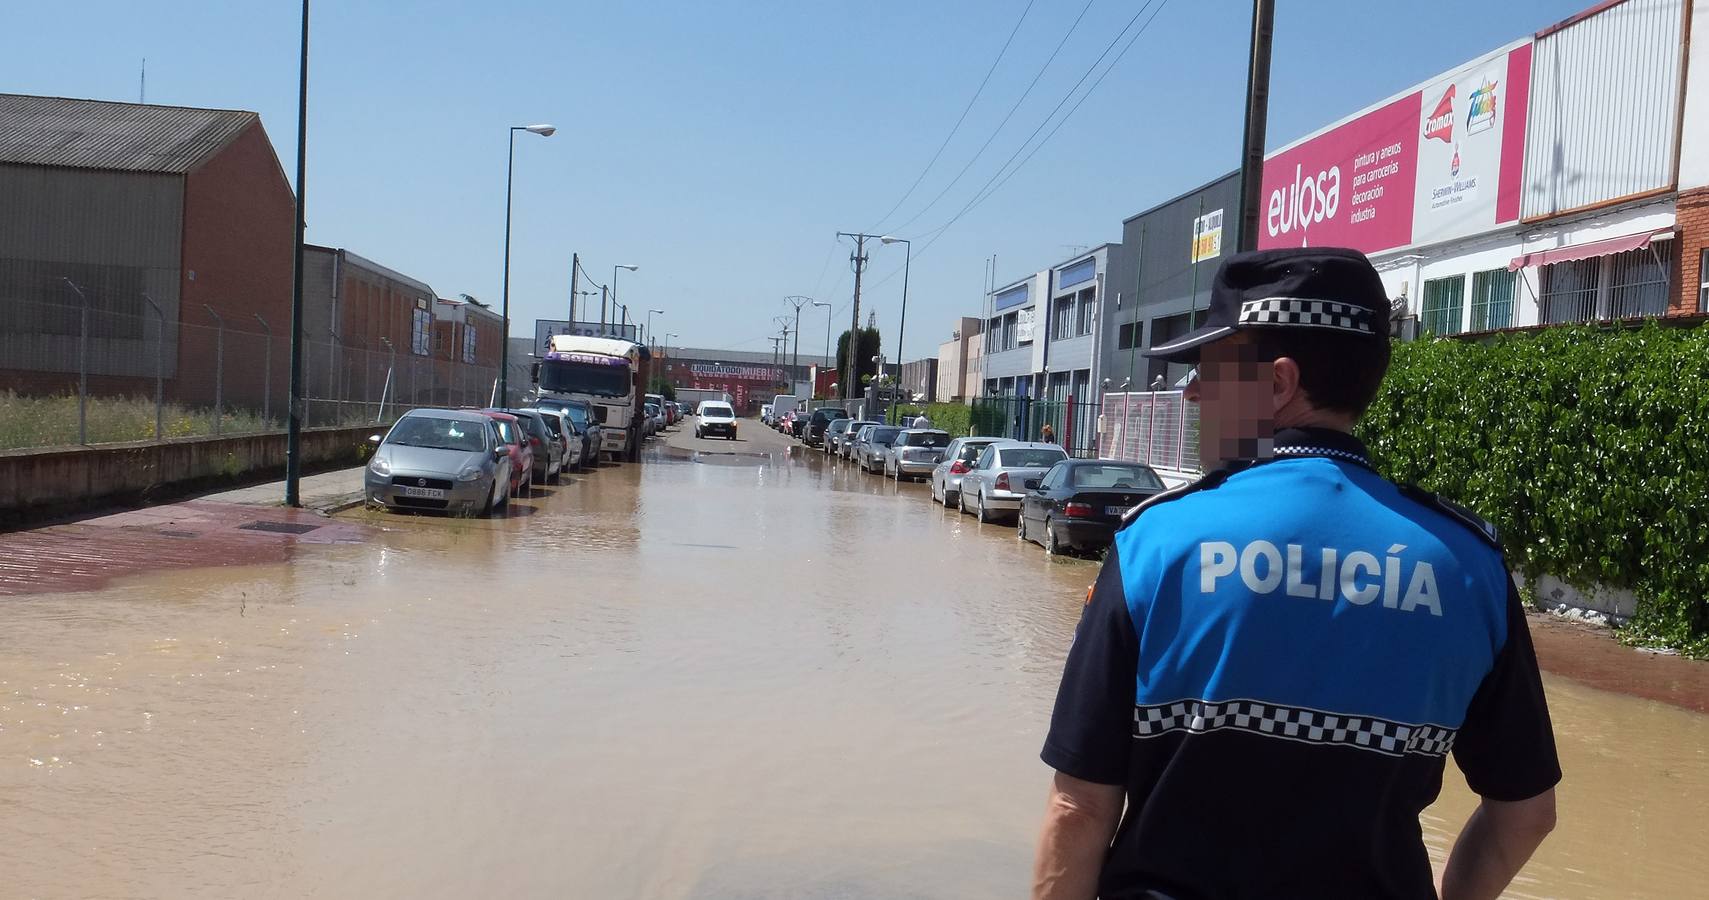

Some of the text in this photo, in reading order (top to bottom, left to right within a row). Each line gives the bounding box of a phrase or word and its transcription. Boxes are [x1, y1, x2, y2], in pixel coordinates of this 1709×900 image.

[1354, 151, 1375, 173] pintura
[1380, 141, 1402, 160] anexos
[1353, 160, 1399, 190] para carrocerías
[1267, 163, 1340, 237] eulosa
[1352, 184, 1384, 206] decoración
[1350, 205, 1376, 224] industria
[1200, 539, 1443, 617] POLICÍA
